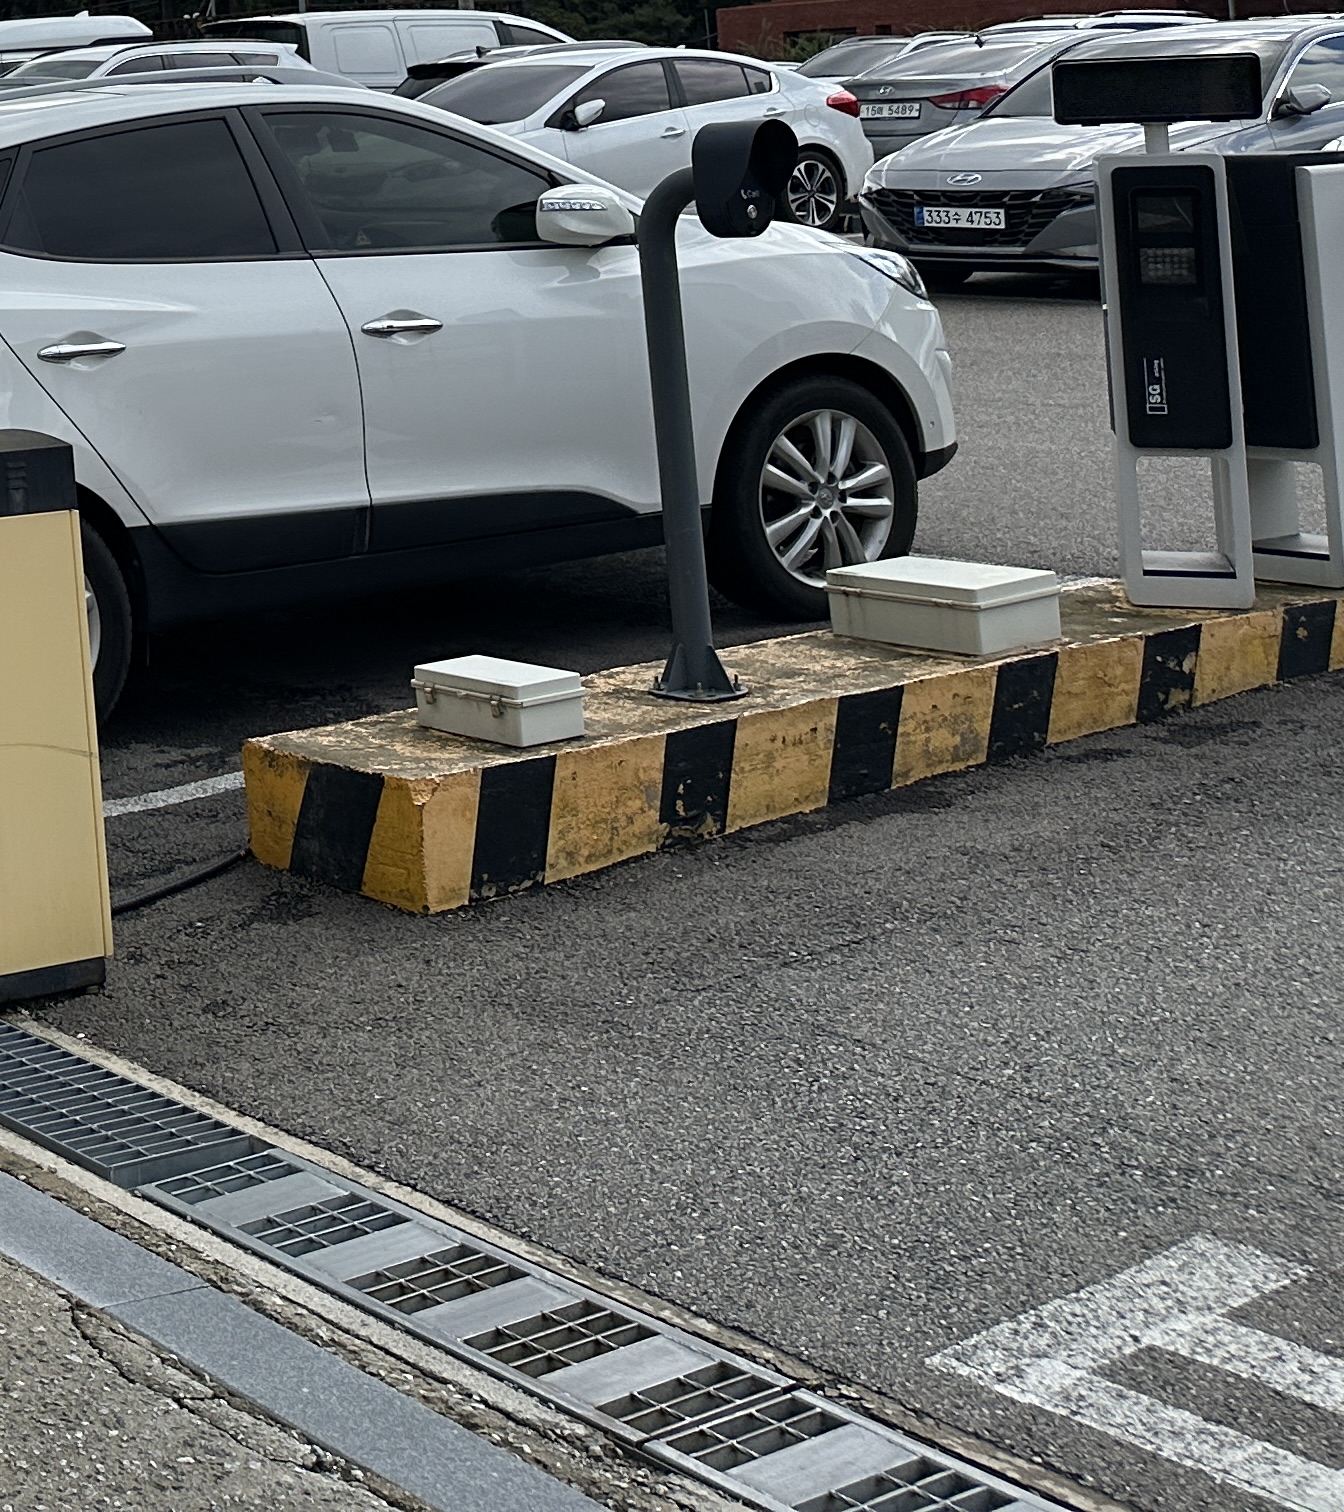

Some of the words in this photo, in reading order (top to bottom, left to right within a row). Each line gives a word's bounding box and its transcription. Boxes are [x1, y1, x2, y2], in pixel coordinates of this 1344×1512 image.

[888, 104, 914, 115] 5489
[925, 210, 962, 225] 333수
[966, 210, 1002, 226] 4753
